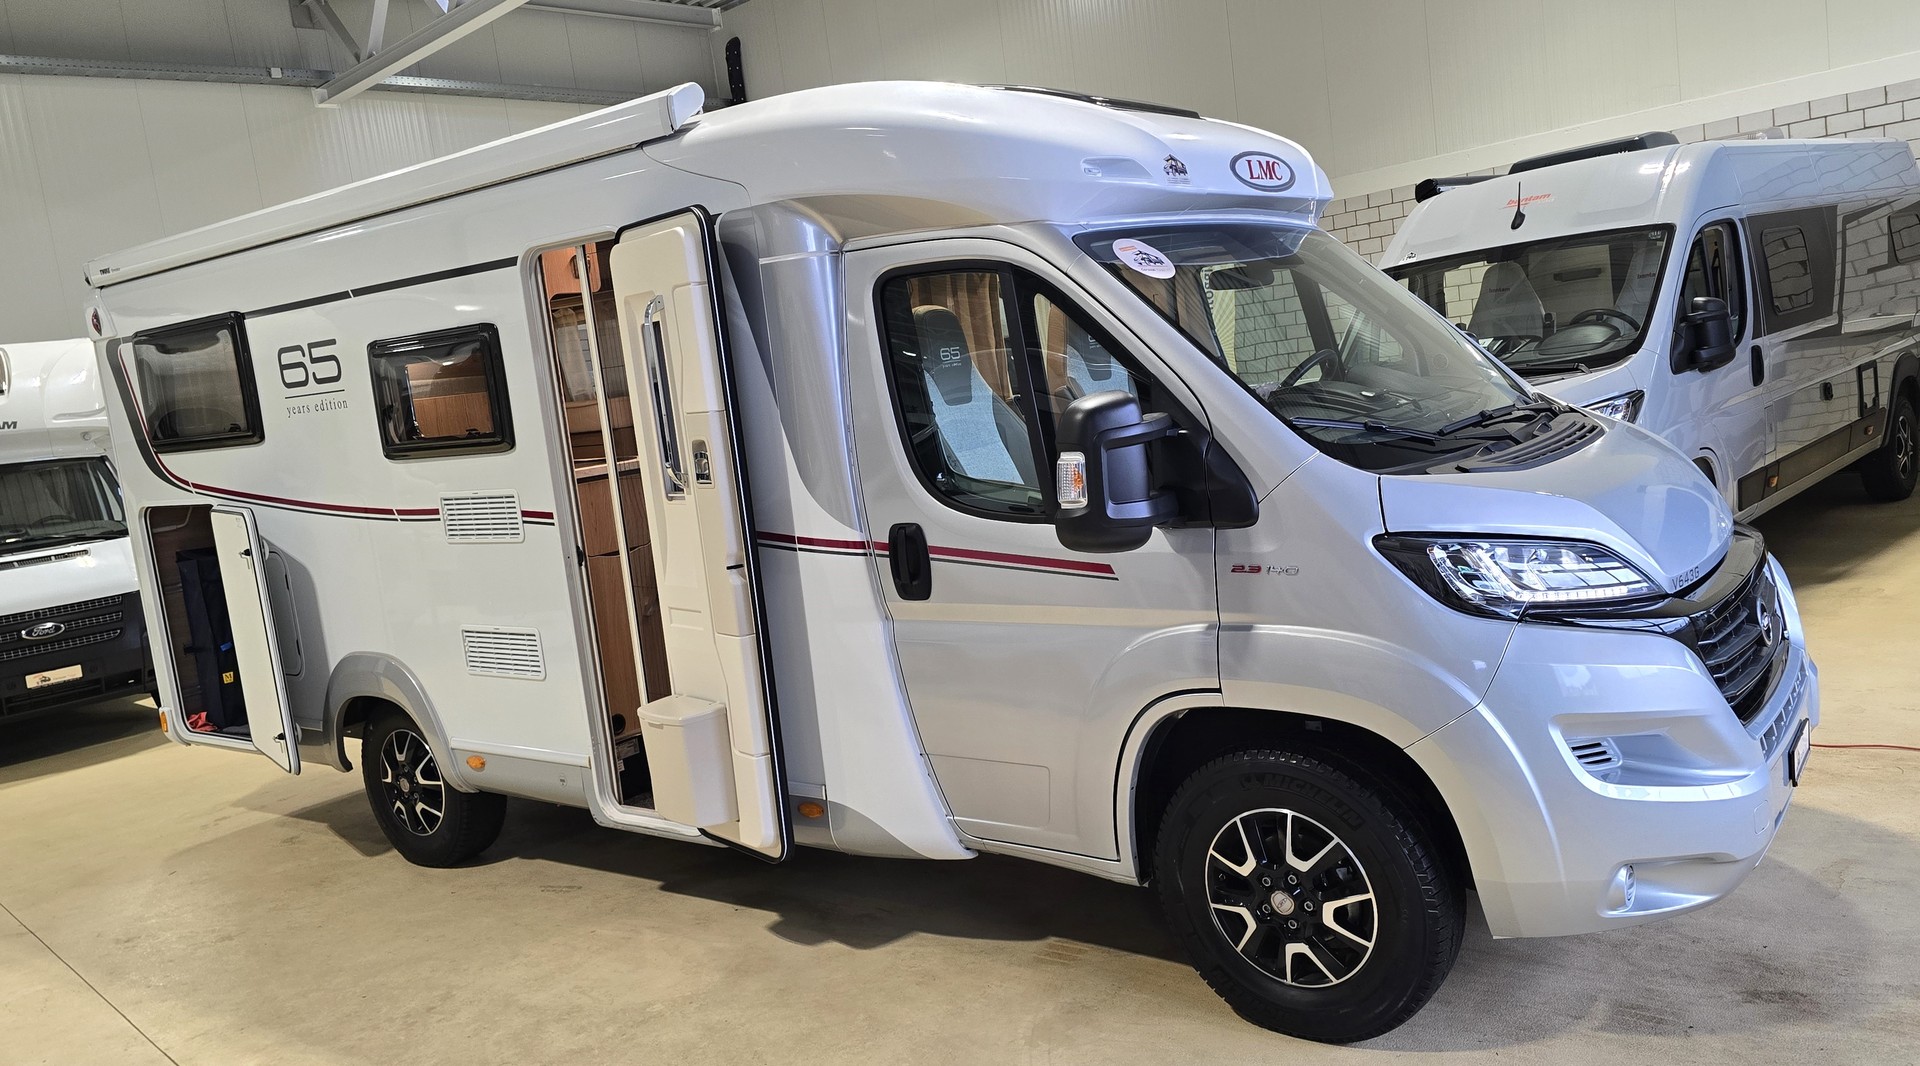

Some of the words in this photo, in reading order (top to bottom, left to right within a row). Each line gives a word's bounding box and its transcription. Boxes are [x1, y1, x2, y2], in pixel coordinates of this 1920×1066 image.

[1245, 159, 1283, 181] LMC
[277, 338, 342, 389] 65
[940, 346, 961, 361] 65
[286, 404, 311, 418] years
[314, 398, 348, 412] edition
[1671, 565, 1700, 591] V643G
[32, 625, 56, 637] Ford
[1263, 773, 1367, 831] MICHELIN
